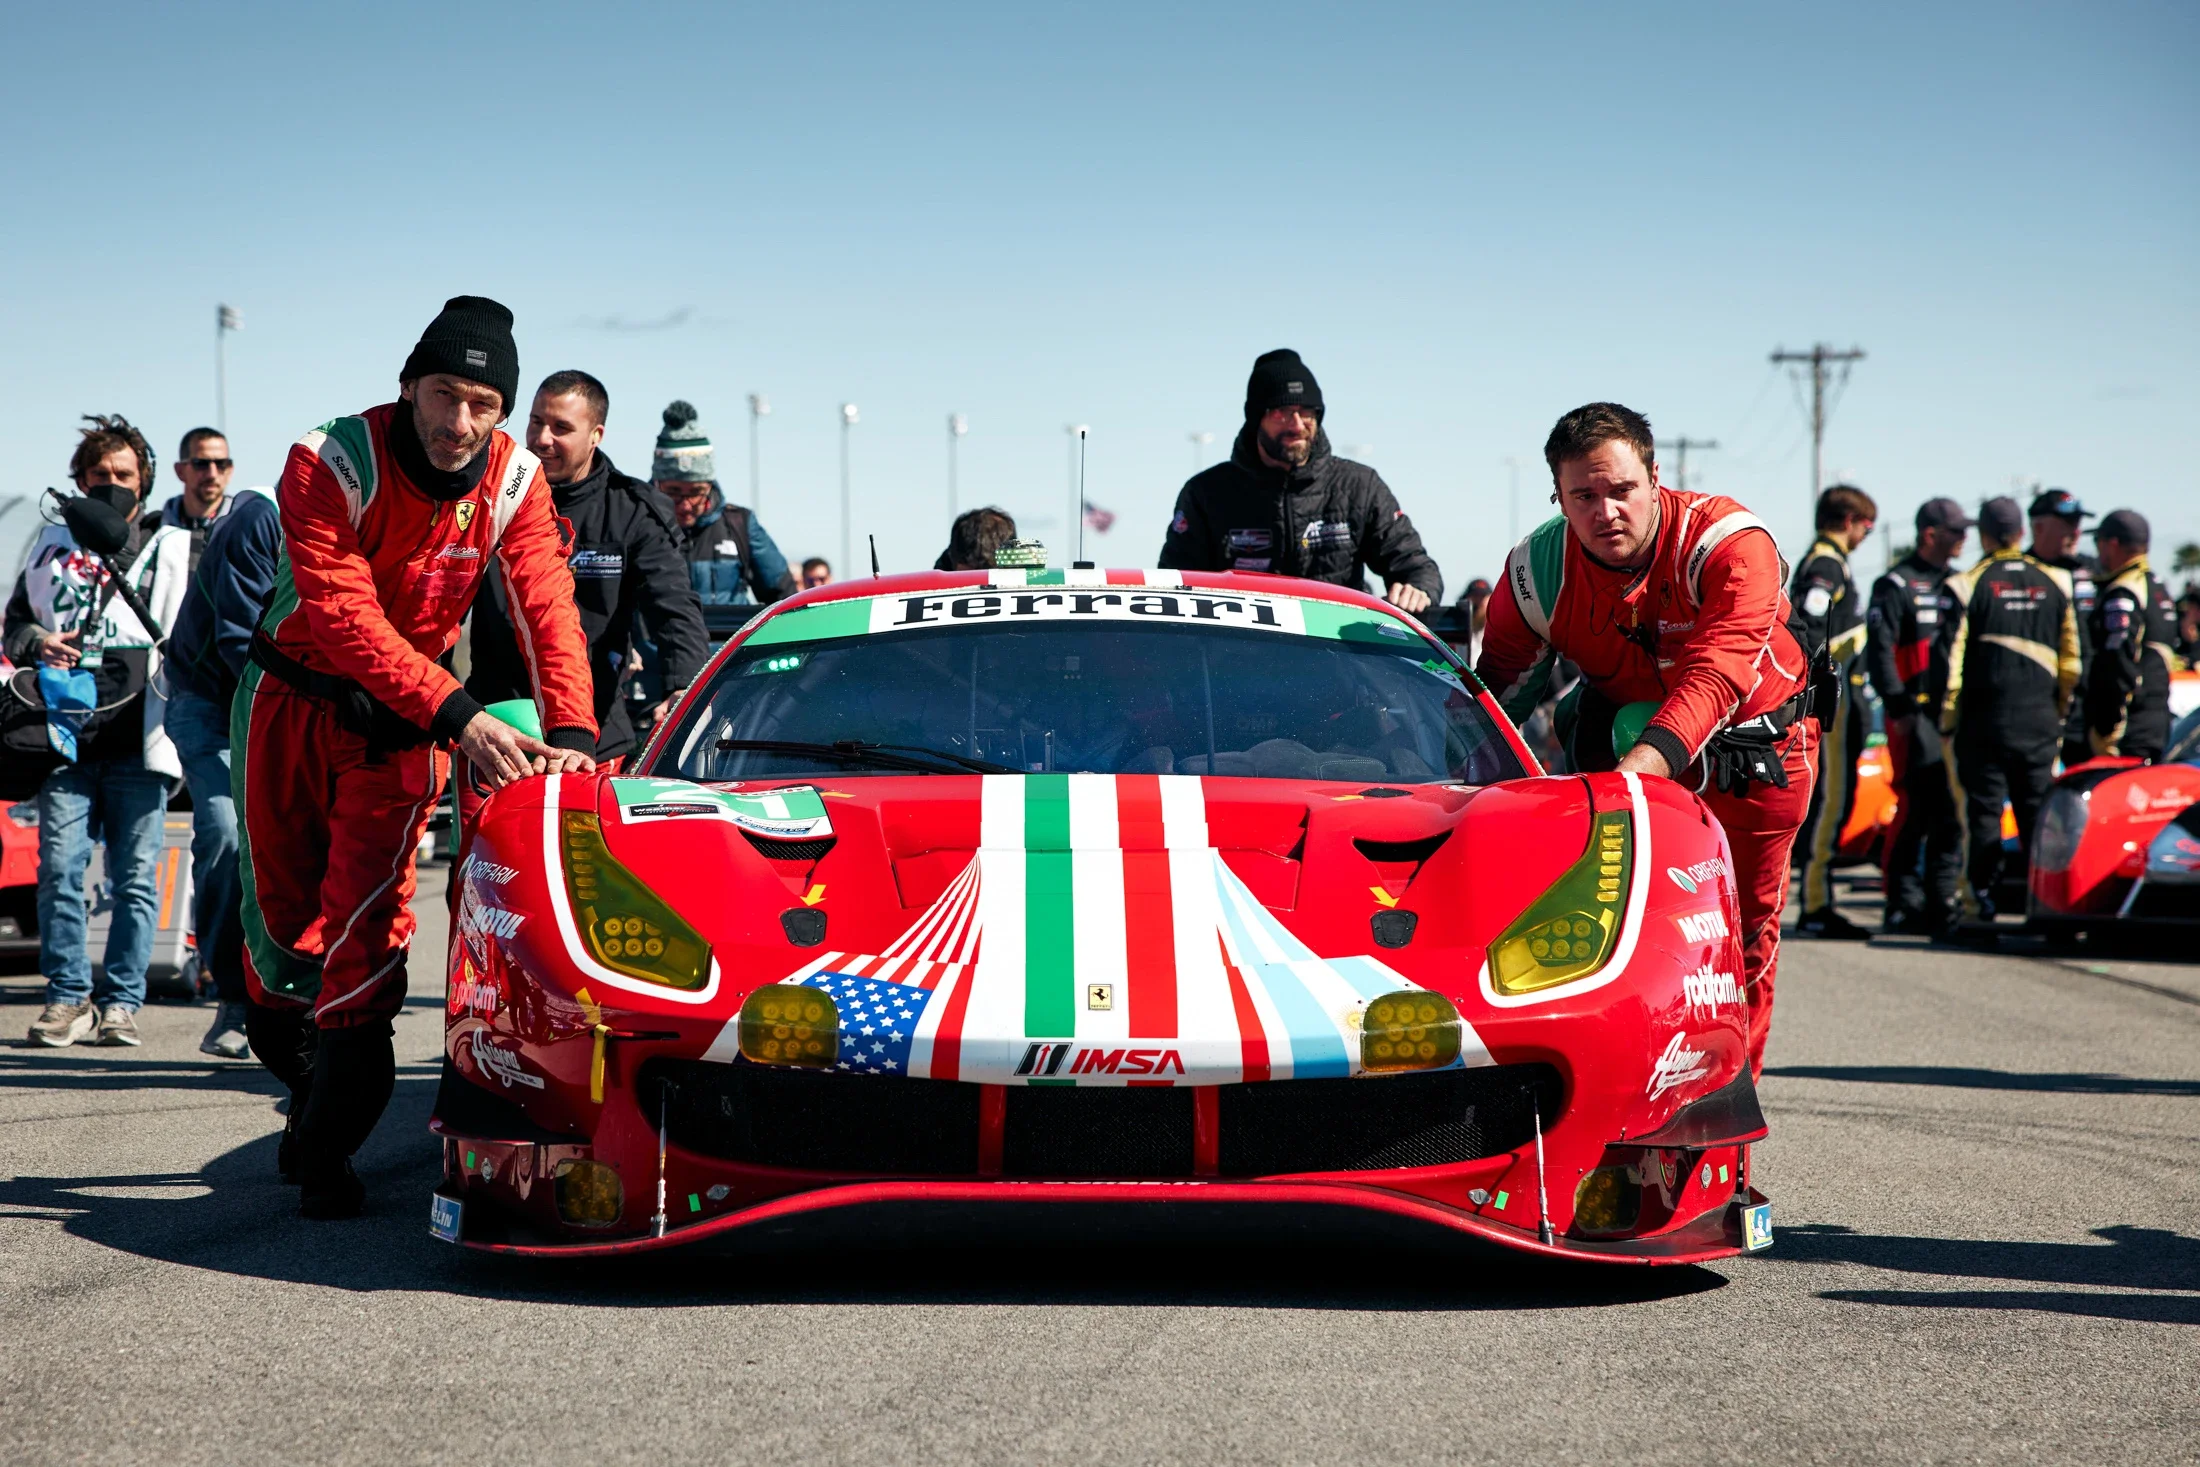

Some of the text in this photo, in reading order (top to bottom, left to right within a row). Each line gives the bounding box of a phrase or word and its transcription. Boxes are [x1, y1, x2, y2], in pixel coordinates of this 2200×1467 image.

[332, 455, 361, 490] Sabelt
[506, 464, 527, 499] Sabelt
[1516, 565, 1533, 601] Sabelt
[893, 593, 1282, 627] Ferrari
[470, 861, 519, 885] ORIFARM
[1687, 857, 1728, 883] ORIFARM
[471, 904, 526, 939] MOTUL
[1677, 910, 1729, 944] MOTUL
[1683, 964, 1738, 1019] rotiform
[1069, 1049, 1186, 1075] IMSA
